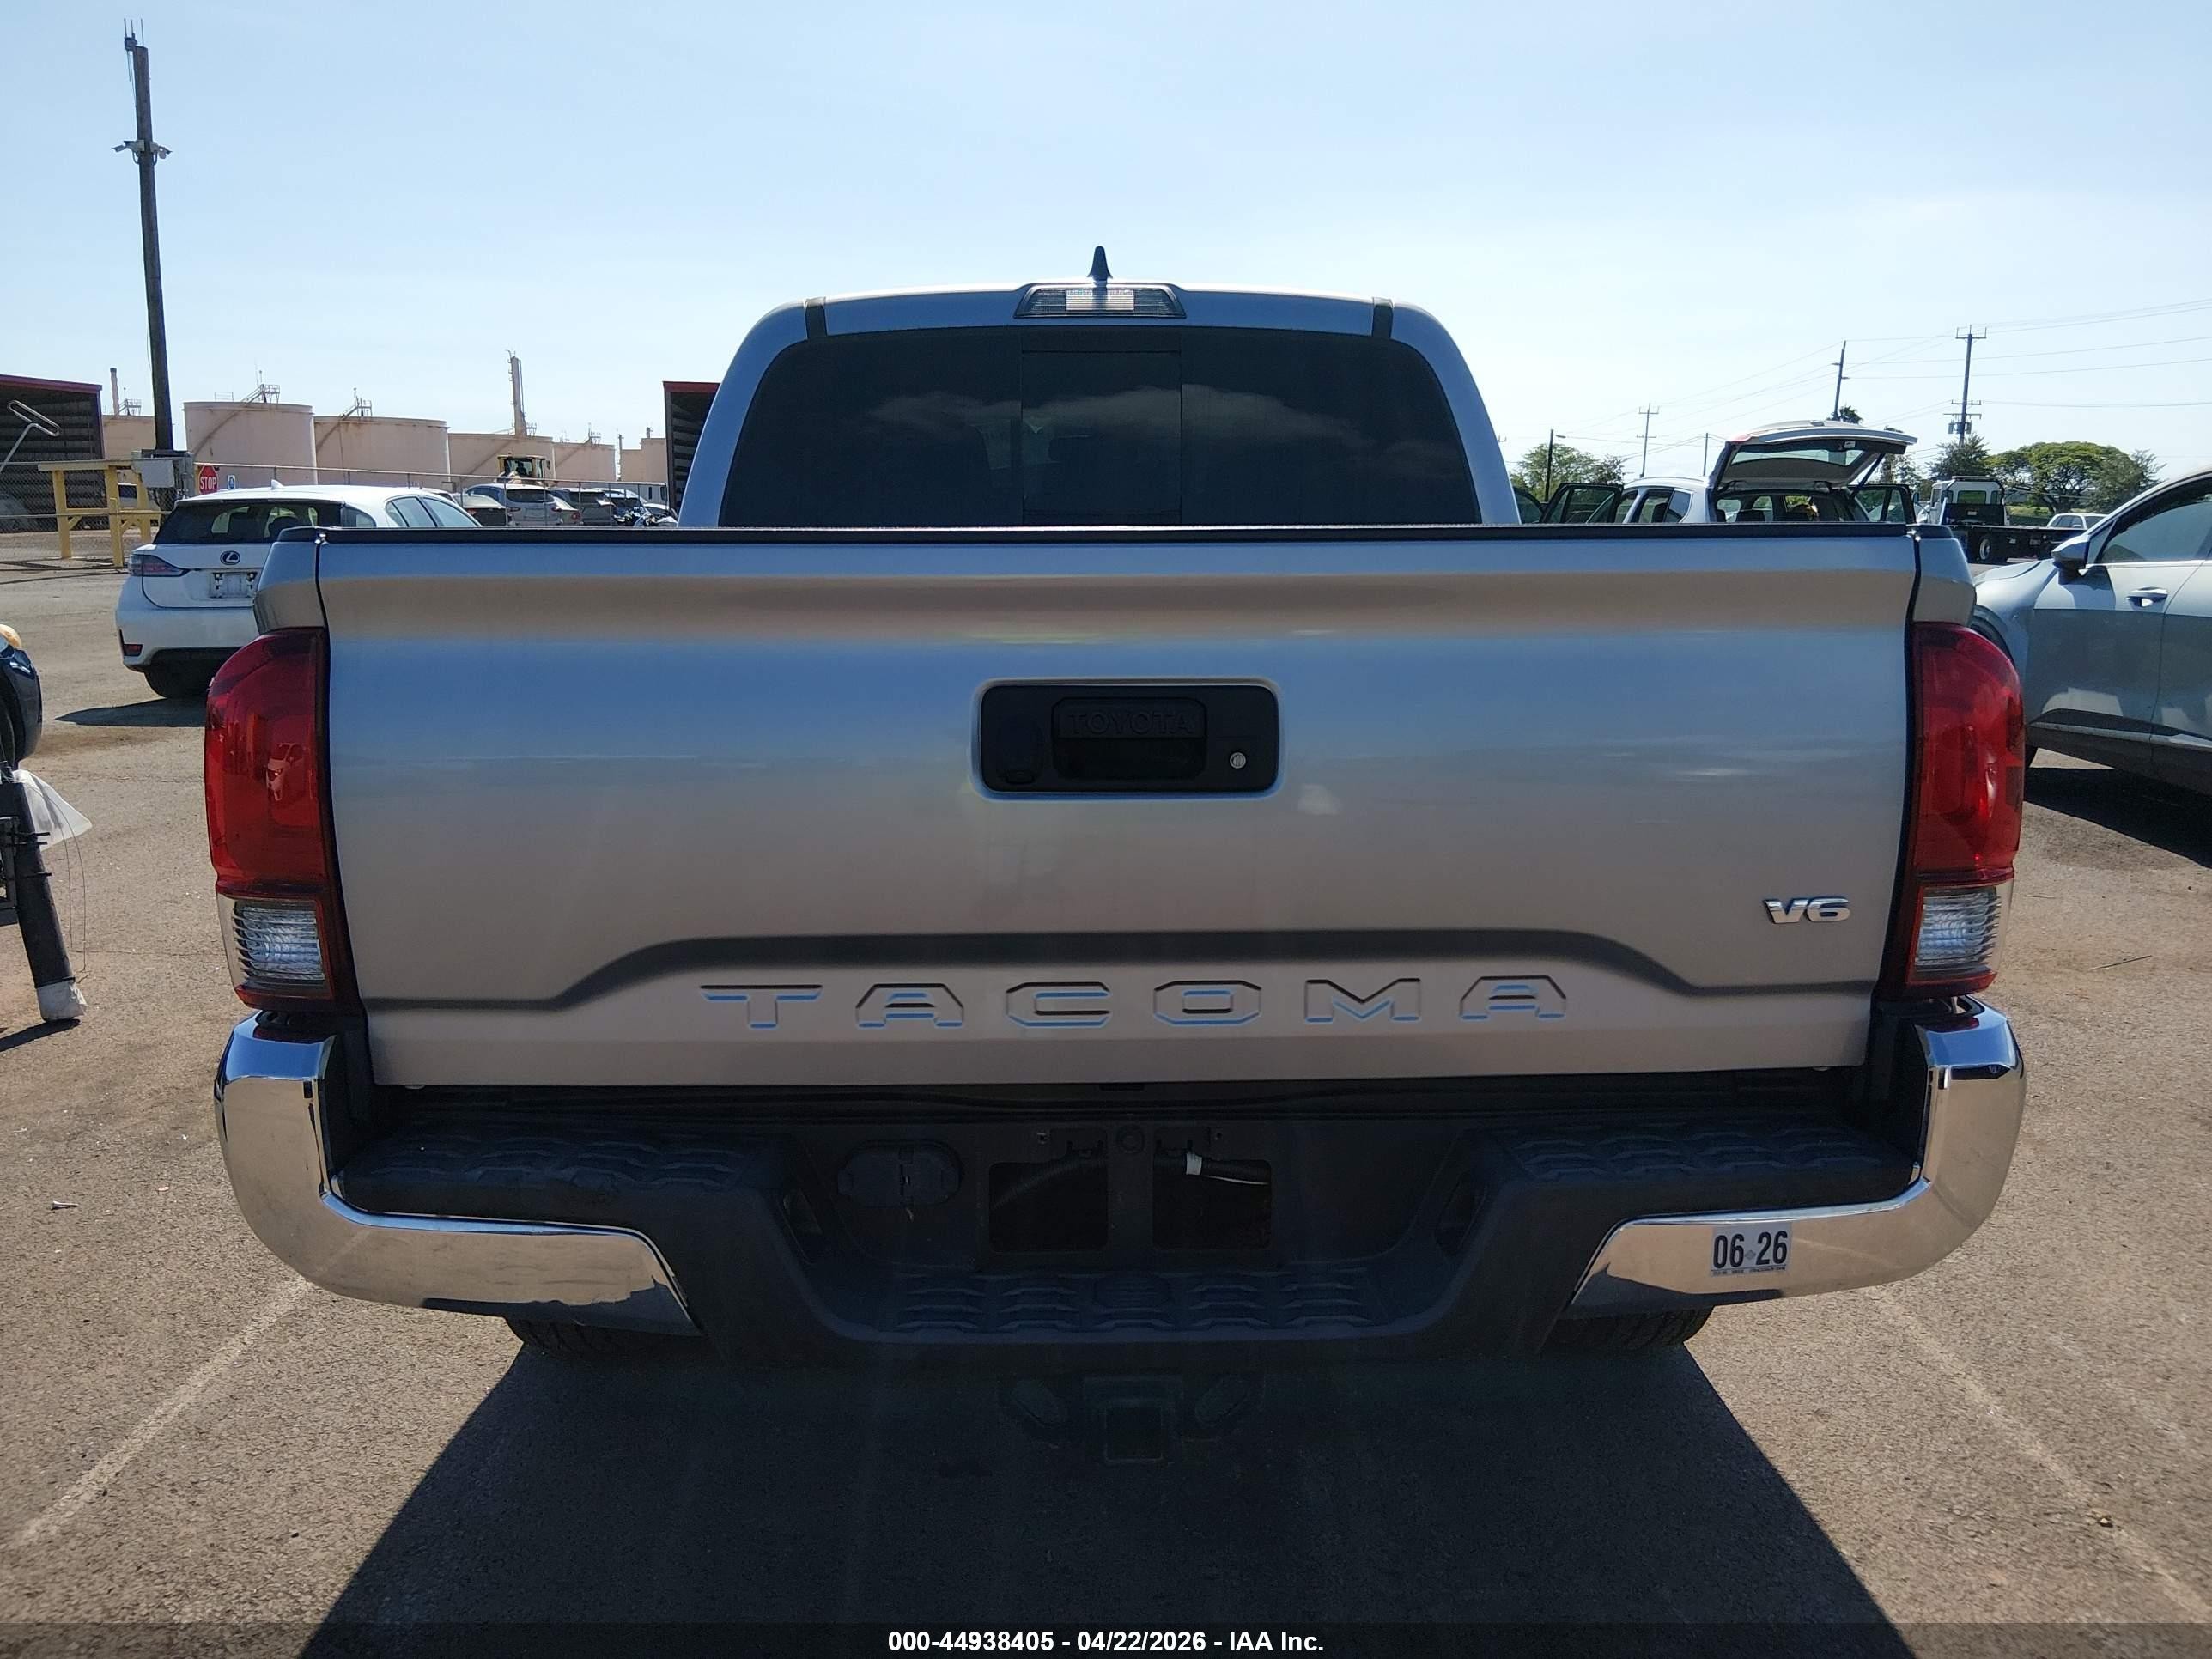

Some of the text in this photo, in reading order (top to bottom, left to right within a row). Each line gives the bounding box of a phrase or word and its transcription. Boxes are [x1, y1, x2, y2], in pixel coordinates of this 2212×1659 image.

[200, 477, 217, 490] STOP
[1068, 711, 1194, 735] TOYOTA
[1763, 897, 1850, 924] V6
[701, 975, 1566, 1030] TACOMA
[1713, 1230, 1789, 1269] 06 26
